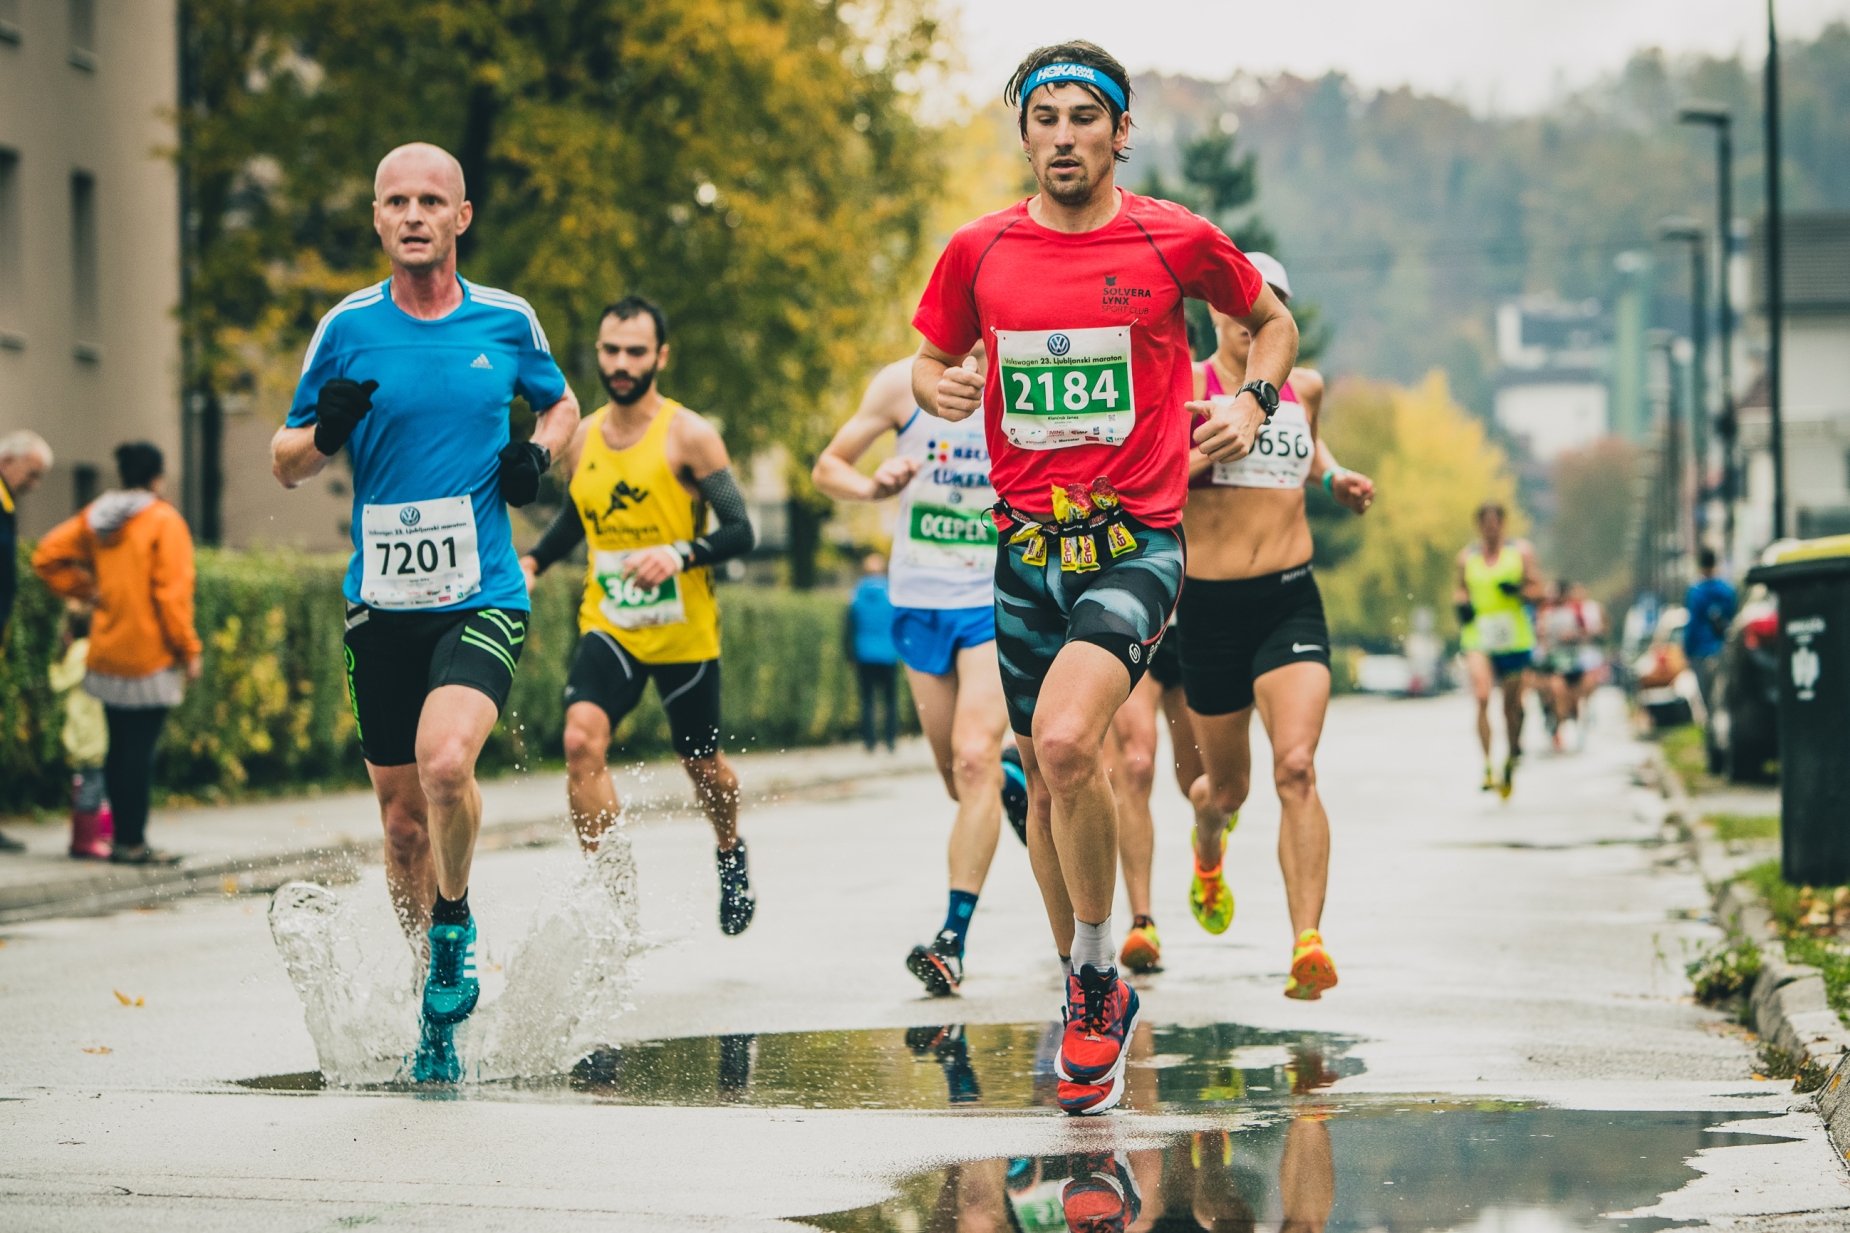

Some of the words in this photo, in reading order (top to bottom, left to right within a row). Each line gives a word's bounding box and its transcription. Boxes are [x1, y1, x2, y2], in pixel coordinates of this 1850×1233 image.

[1036, 64, 1077, 82] HOKA
[1102, 297, 1129, 305] LYNX
[1103, 287, 1151, 298] SOLVERA
[1101, 305, 1127, 313] SPORT
[1129, 306, 1149, 315] CLUB
[1040, 357, 1051, 365] 23.
[1053, 357, 1090, 366] Ljubljanski
[1093, 355, 1122, 363] maraton
[1011, 369, 1119, 411] 2184
[1249, 429, 1308, 459] 656
[921, 513, 988, 541] OCEPEK
[376, 536, 457, 576] 7201
